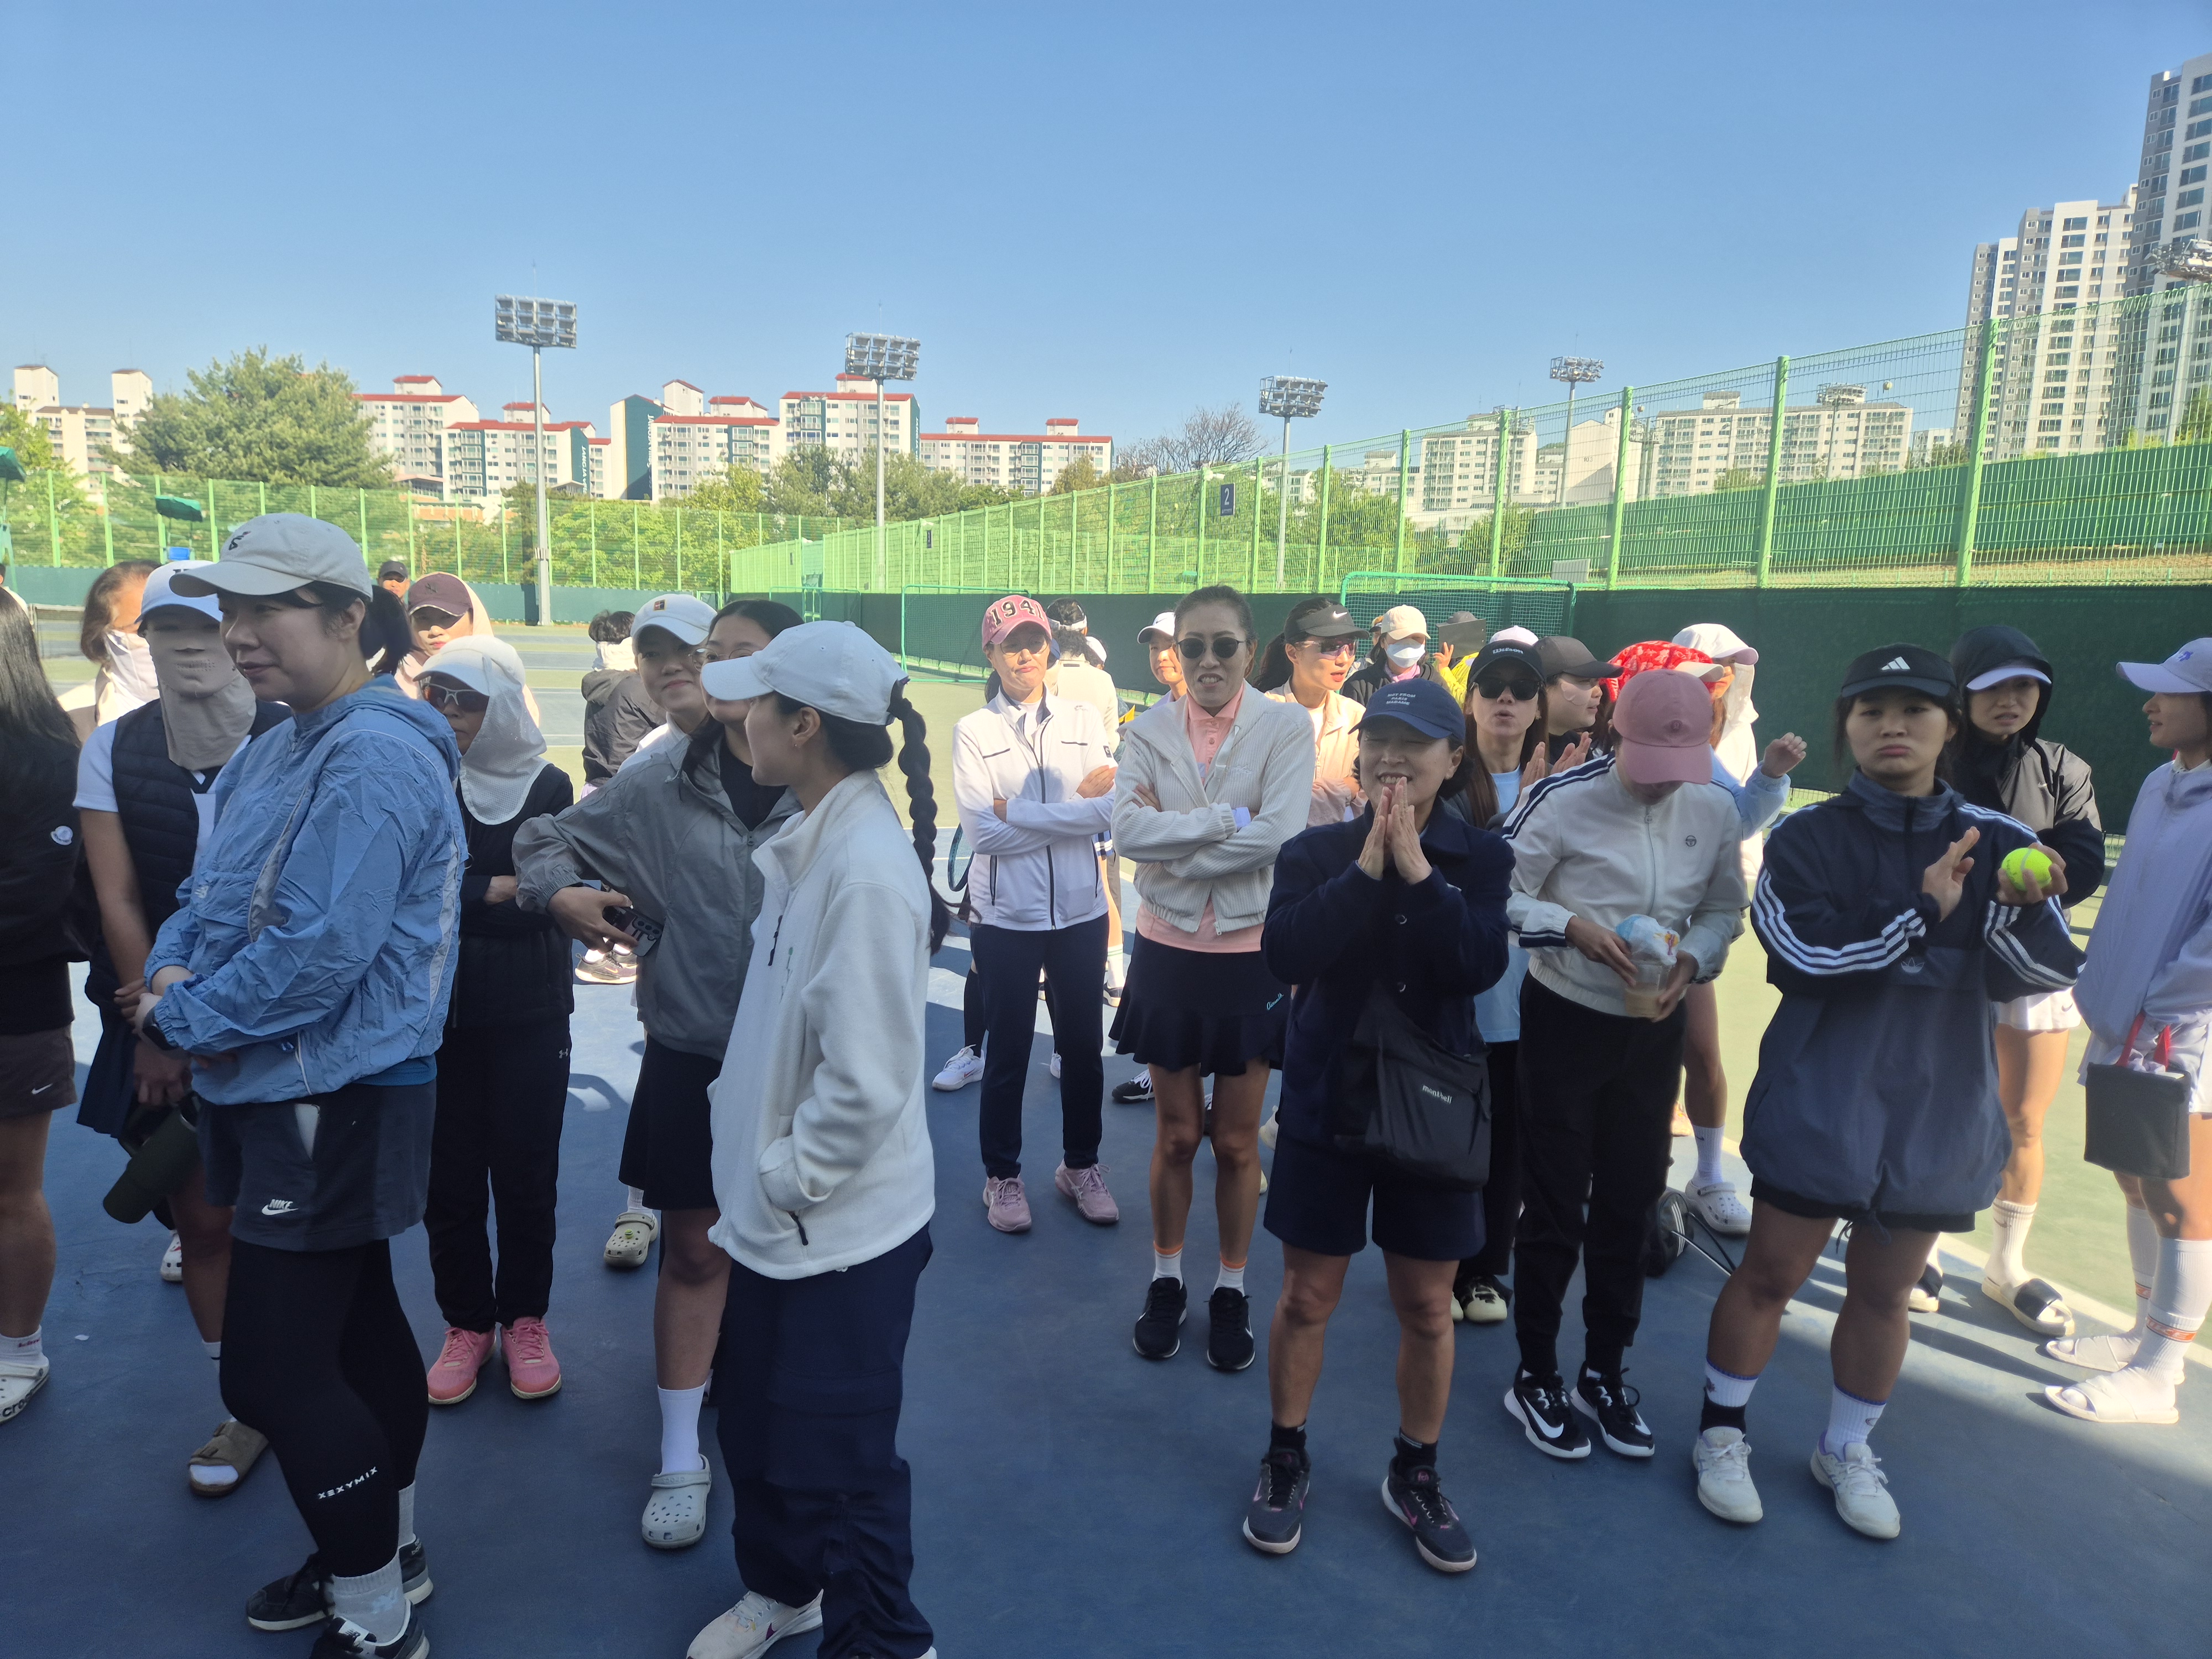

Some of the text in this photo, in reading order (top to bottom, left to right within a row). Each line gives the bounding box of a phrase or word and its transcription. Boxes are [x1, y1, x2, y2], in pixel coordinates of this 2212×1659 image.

[1224, 487, 1230, 505] 2
[990, 599, 1045, 627] 1941
[269, 1199, 293, 1211] NIKE
[318, 1466, 378, 1500] XEXYMIX
